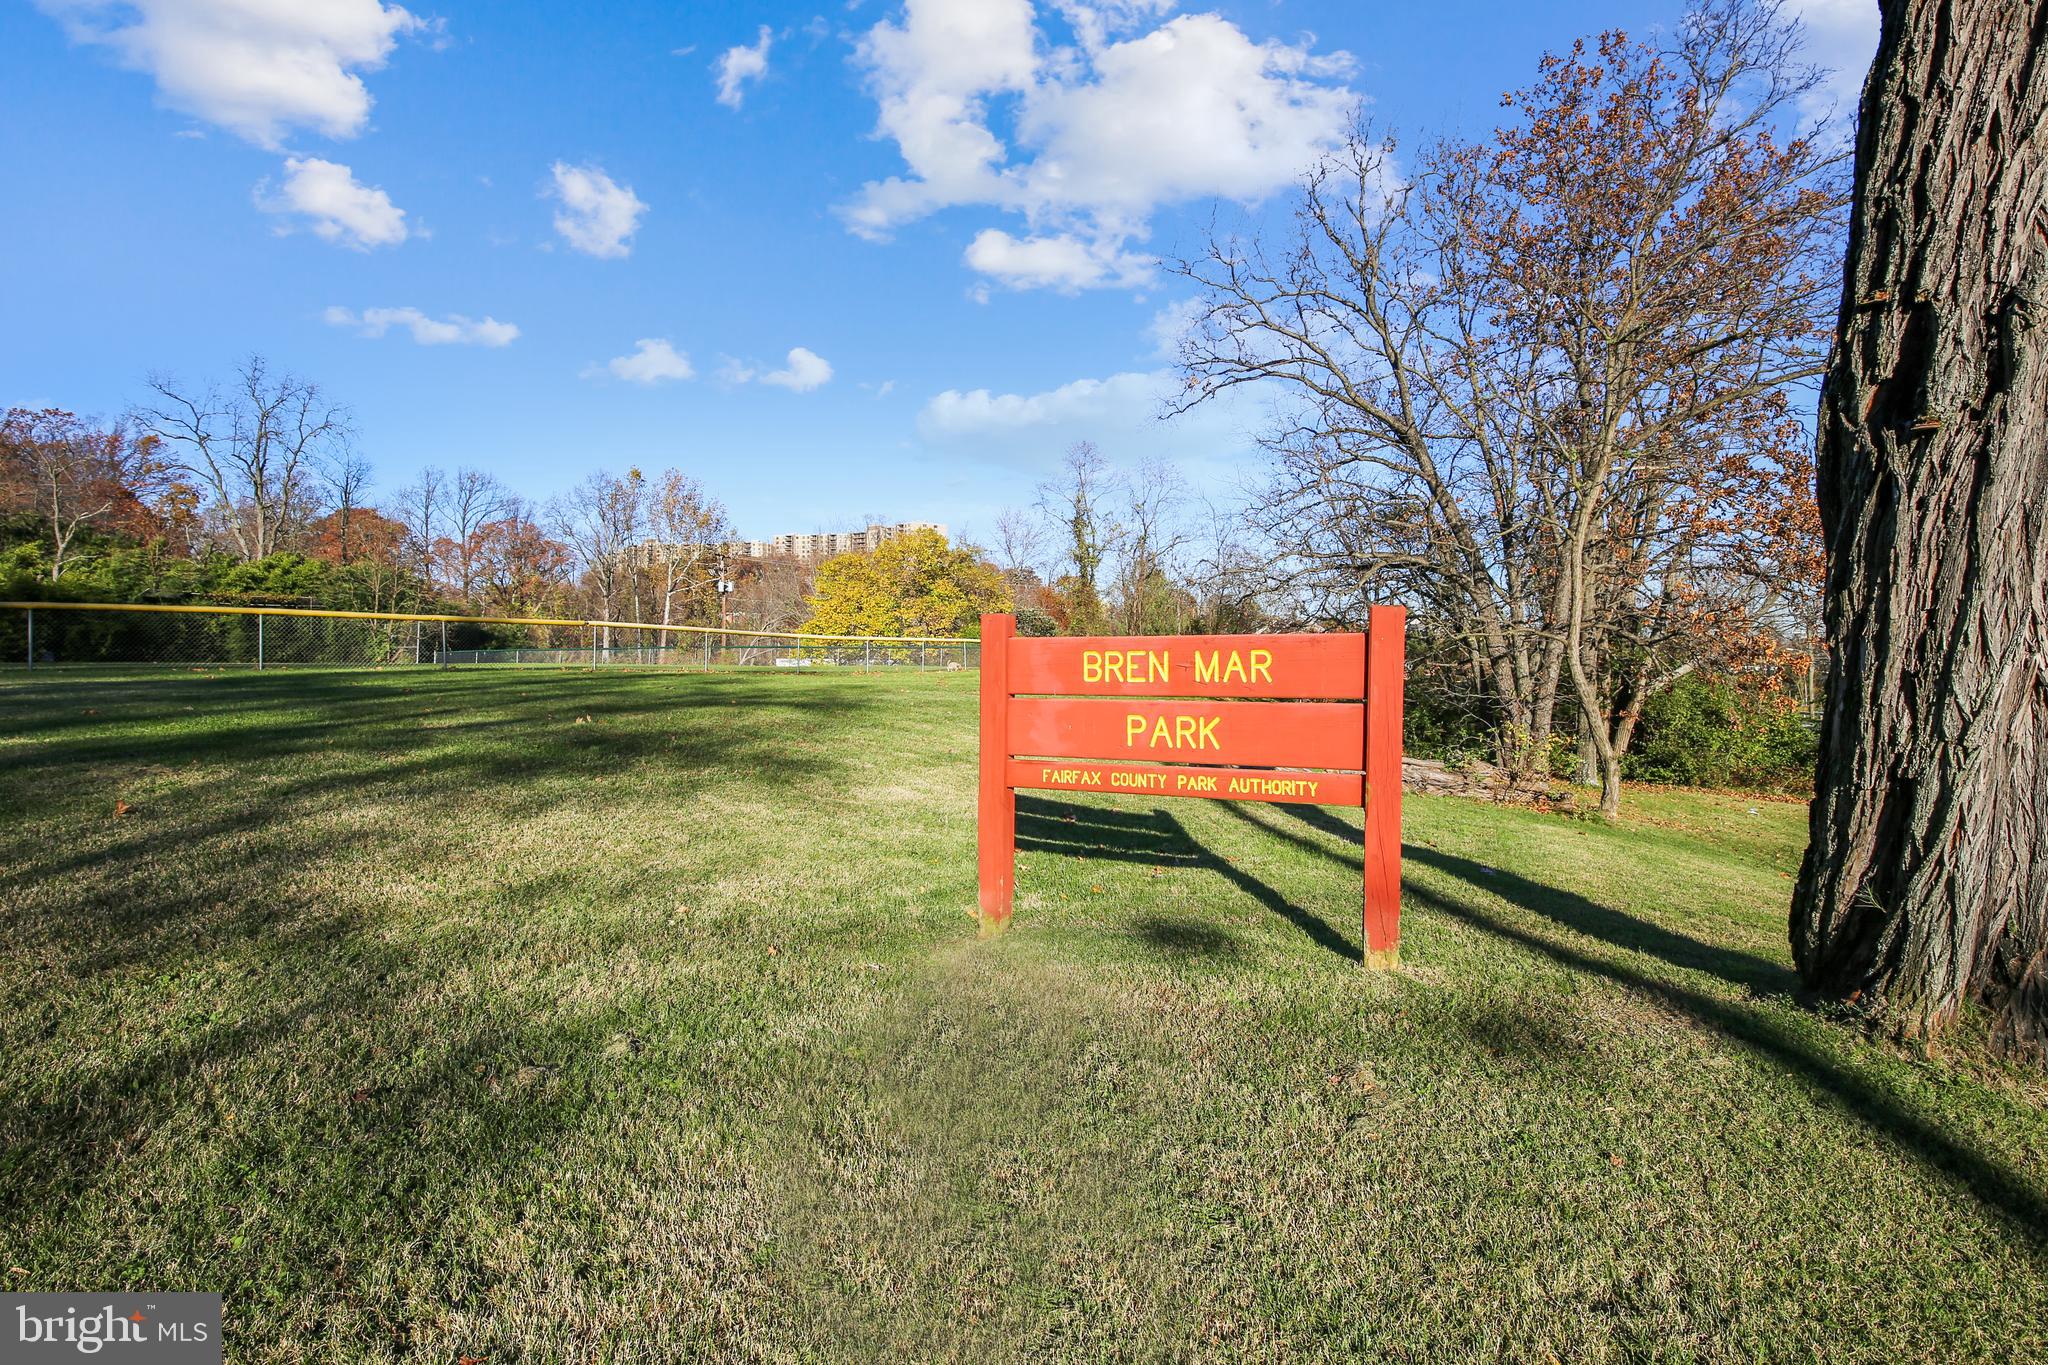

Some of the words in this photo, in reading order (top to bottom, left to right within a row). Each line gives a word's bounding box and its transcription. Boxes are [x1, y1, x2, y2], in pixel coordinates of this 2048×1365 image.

[1082, 650, 1169, 684] BREN
[1194, 649, 1273, 684] MAR
[1126, 714, 1221, 751] PARK
[1042, 768, 1102, 786] FAIRFAX
[1110, 772, 1167, 790] COUNTY
[1177, 774, 1217, 792] PARK
[1229, 777, 1319, 798] AUTHORITY
